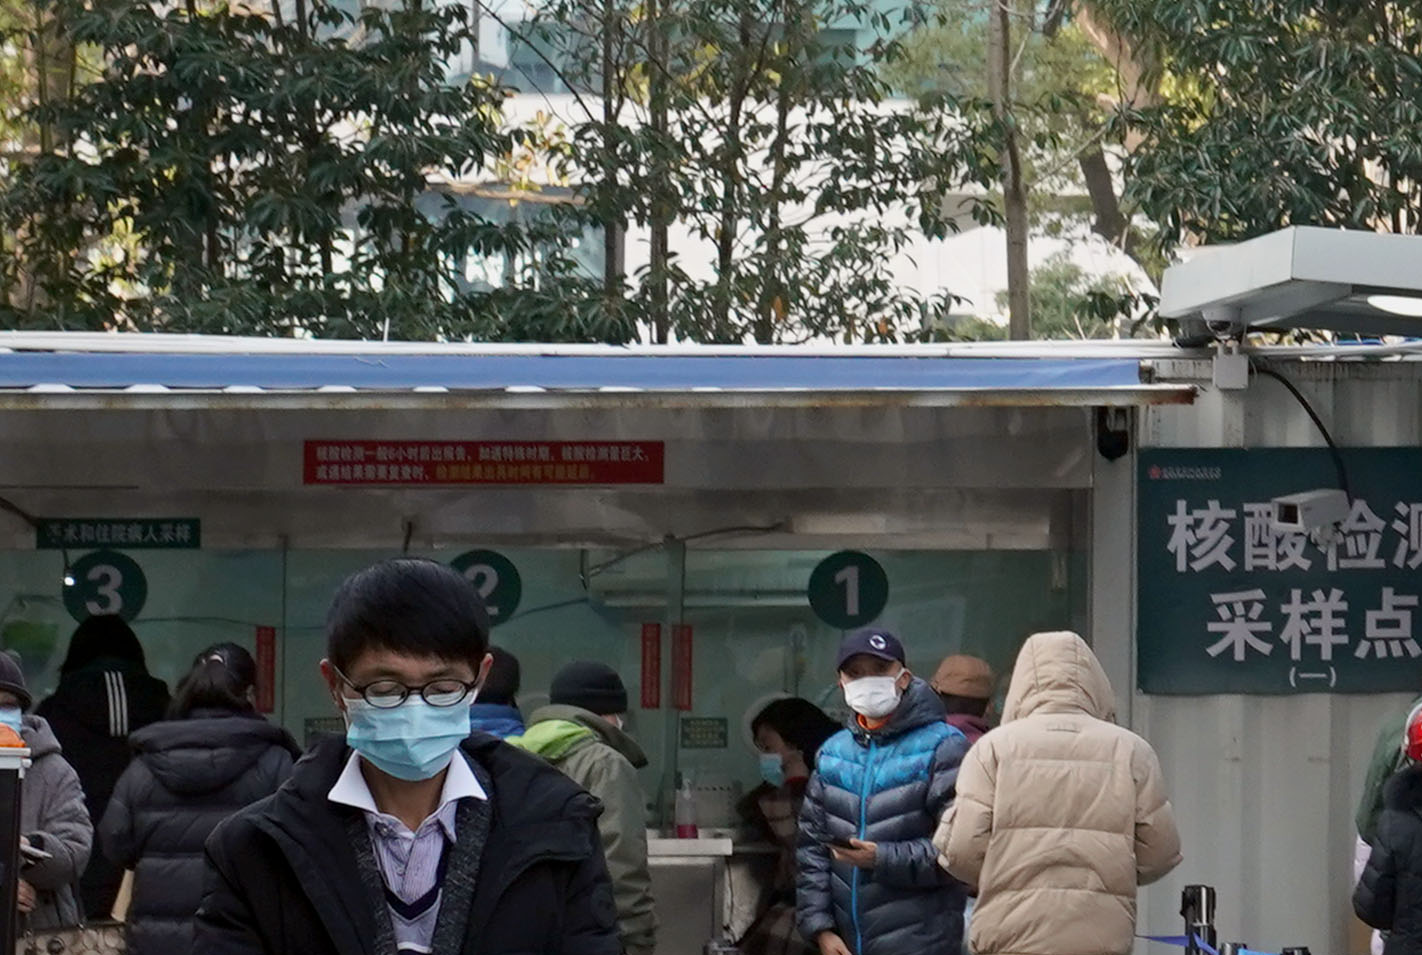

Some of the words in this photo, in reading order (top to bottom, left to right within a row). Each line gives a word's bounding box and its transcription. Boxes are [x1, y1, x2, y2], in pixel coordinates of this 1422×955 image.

[86, 563, 123, 616] 3
[464, 563, 499, 616] 2
[834, 565, 861, 616] 1
[1205, 586, 1422, 661] 采样点
